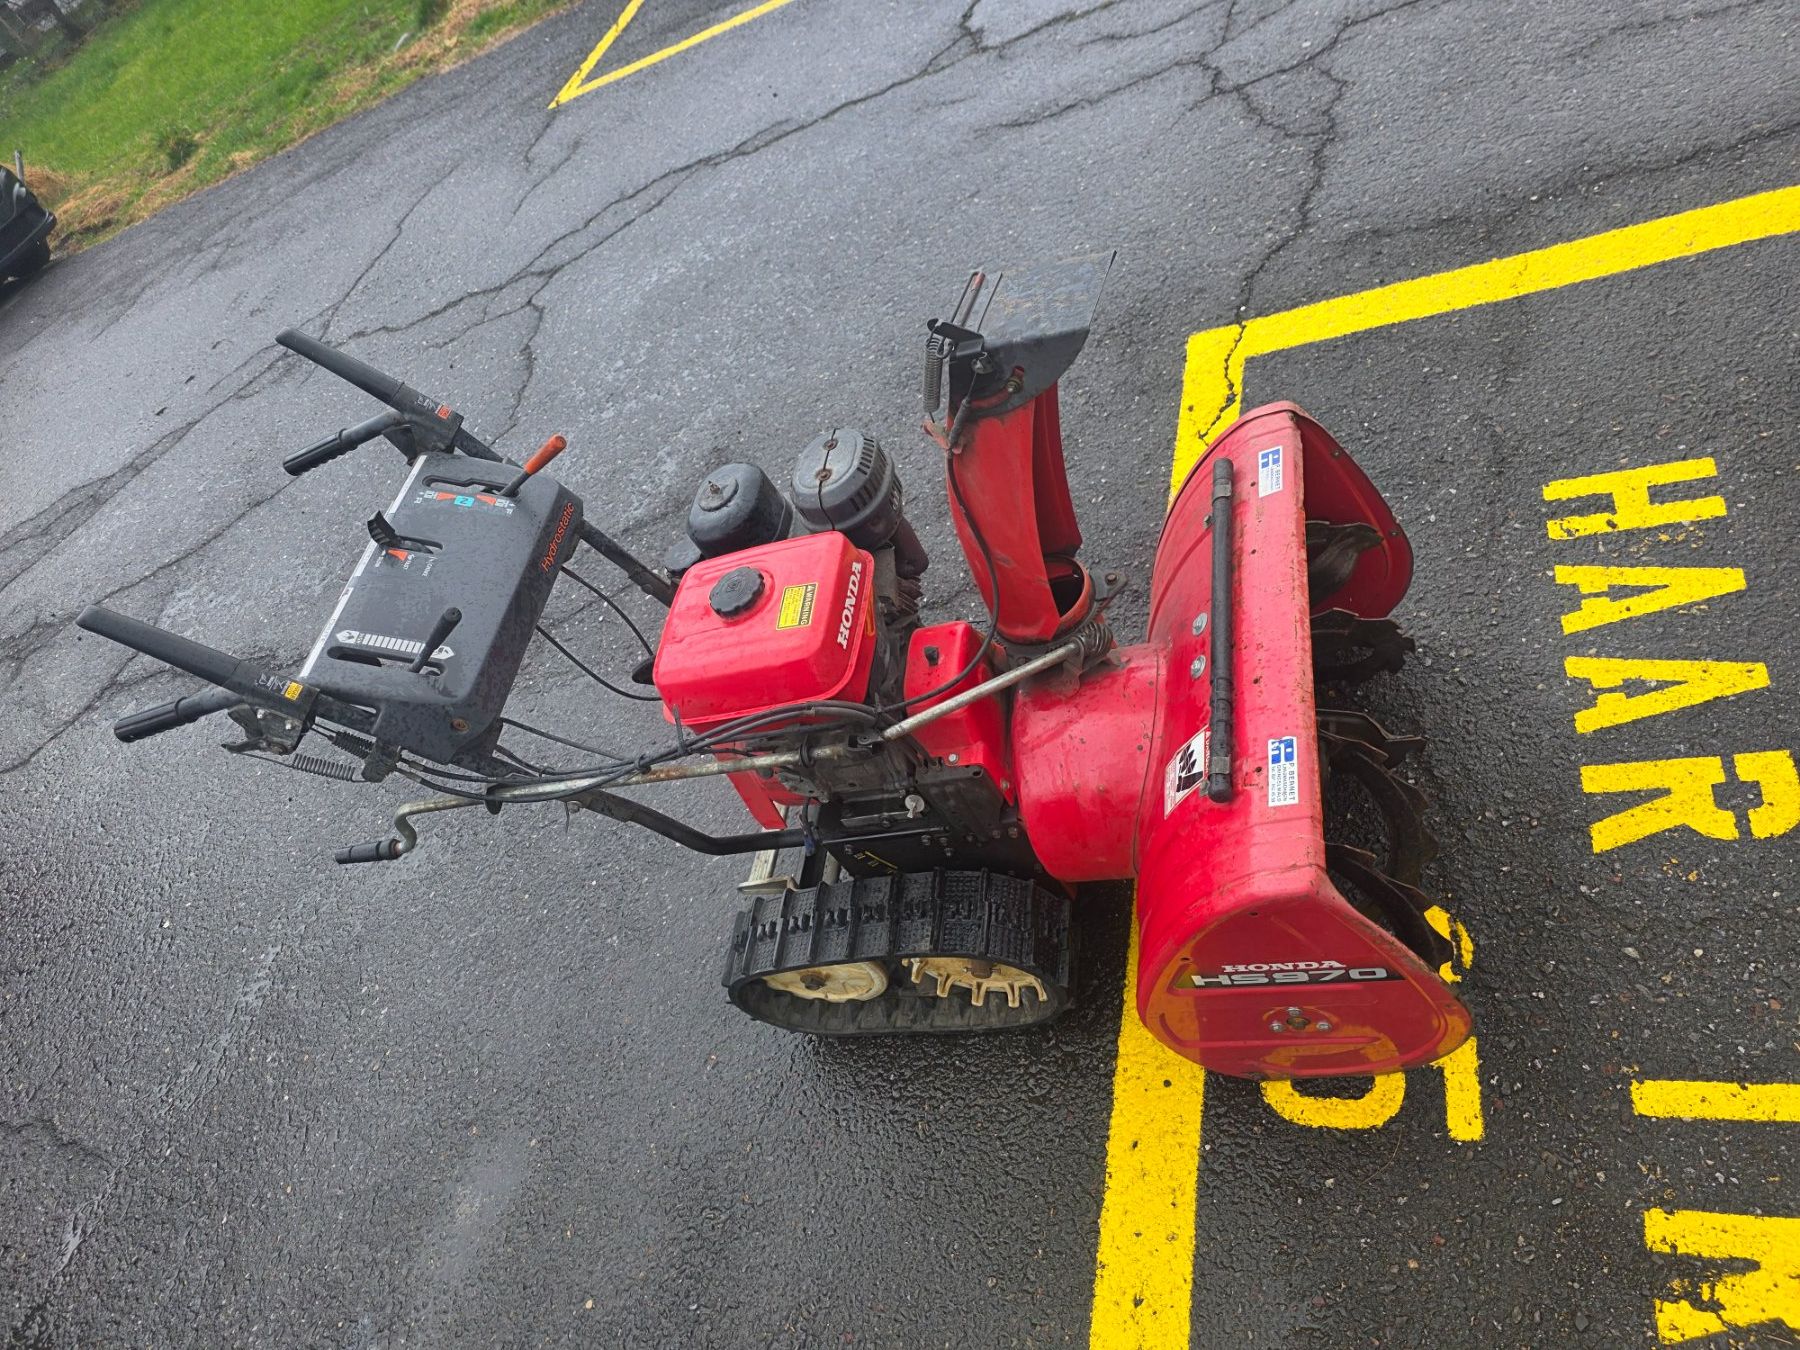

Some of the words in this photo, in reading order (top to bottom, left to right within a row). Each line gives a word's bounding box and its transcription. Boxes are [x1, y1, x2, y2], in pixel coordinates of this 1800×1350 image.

[541, 502, 575, 572] Hydrostatic
[801, 591, 814, 625] WARNING
[837, 562, 862, 649] HONDA
[1542, 457, 1800, 855] HAAR
[1288, 771, 1296, 801] BERNET
[1191, 967, 1388, 986] HS970
[1221, 960, 1347, 973] HONDA
